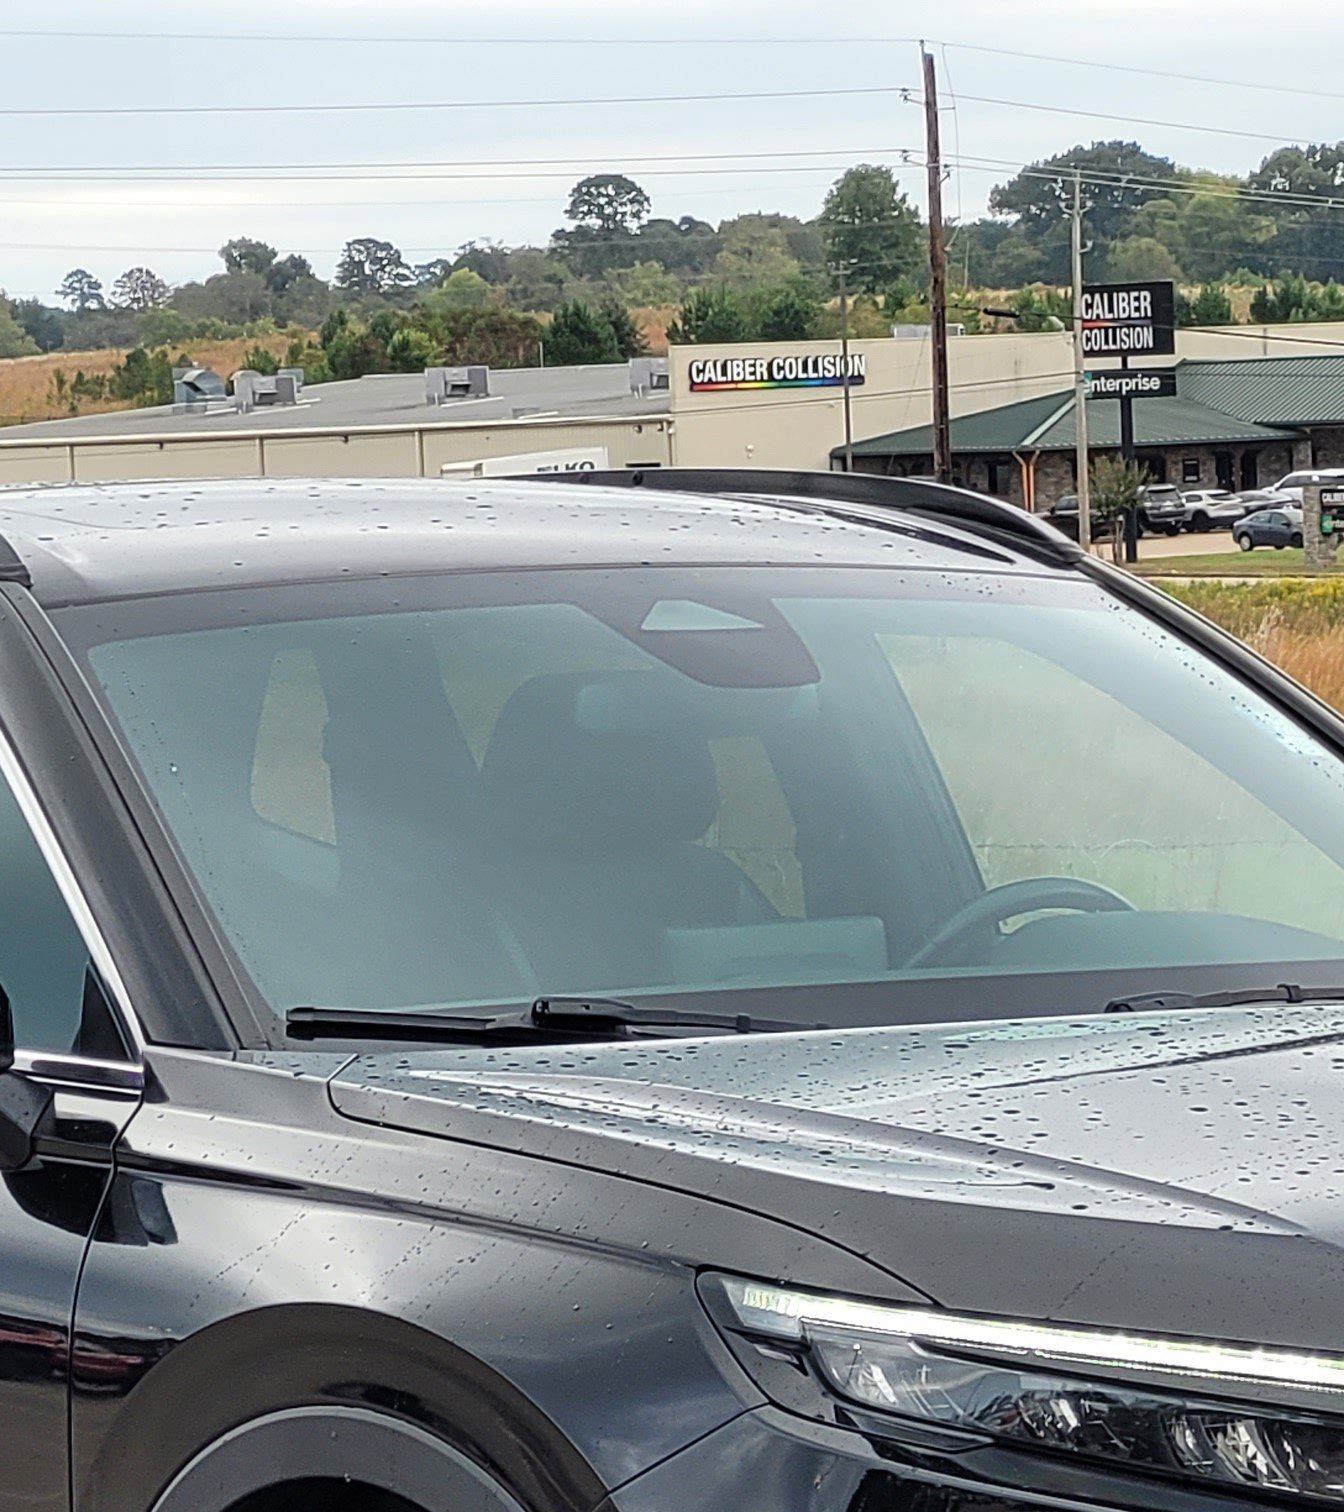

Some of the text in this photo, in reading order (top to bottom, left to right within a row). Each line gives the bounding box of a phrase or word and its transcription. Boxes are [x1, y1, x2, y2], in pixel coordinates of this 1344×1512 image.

[1081, 291, 1152, 320] CALIBER
[1082, 326, 1153, 351] COLLISION
[690, 354, 866, 383] CALIBER COLLISION
